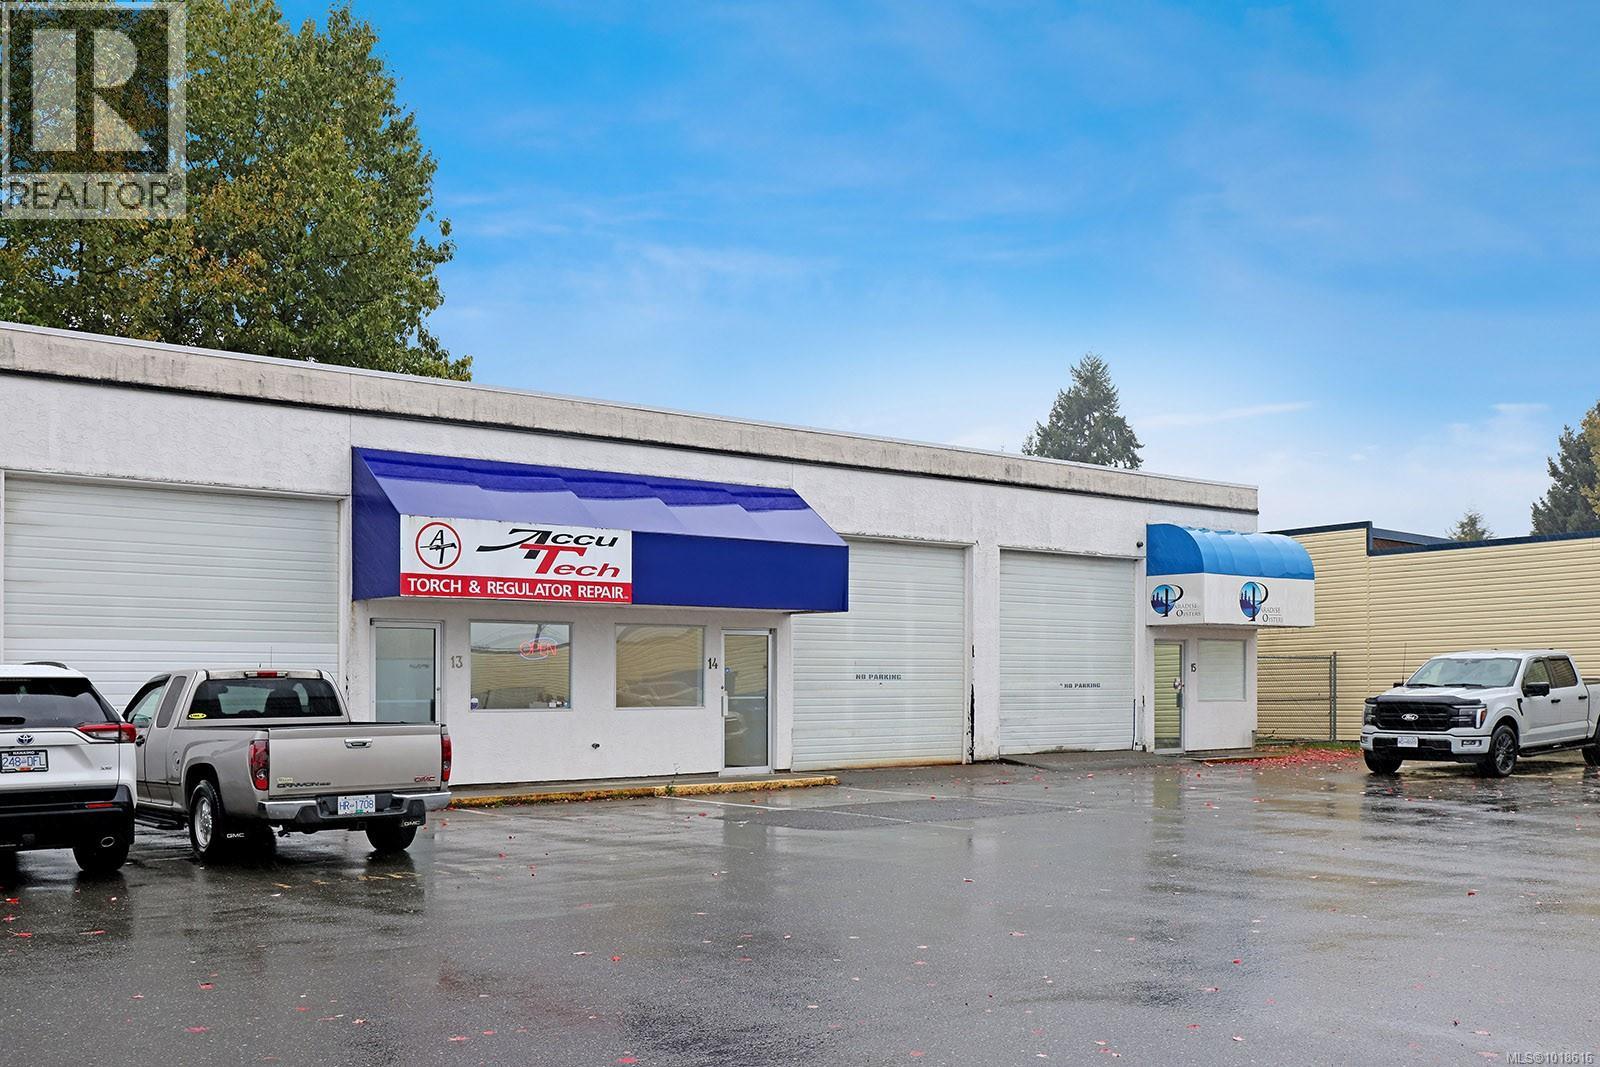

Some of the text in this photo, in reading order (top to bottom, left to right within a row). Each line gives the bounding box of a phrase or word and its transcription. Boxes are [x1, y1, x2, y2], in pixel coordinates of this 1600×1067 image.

[407, 577, 462, 593] TORCH
[468, 580, 481, 594] &
[487, 580, 572, 598] REGULATOR
[450, 656, 463, 668] 13
[707, 657, 718, 669] 14
[868, 673, 902, 681] PARKING
